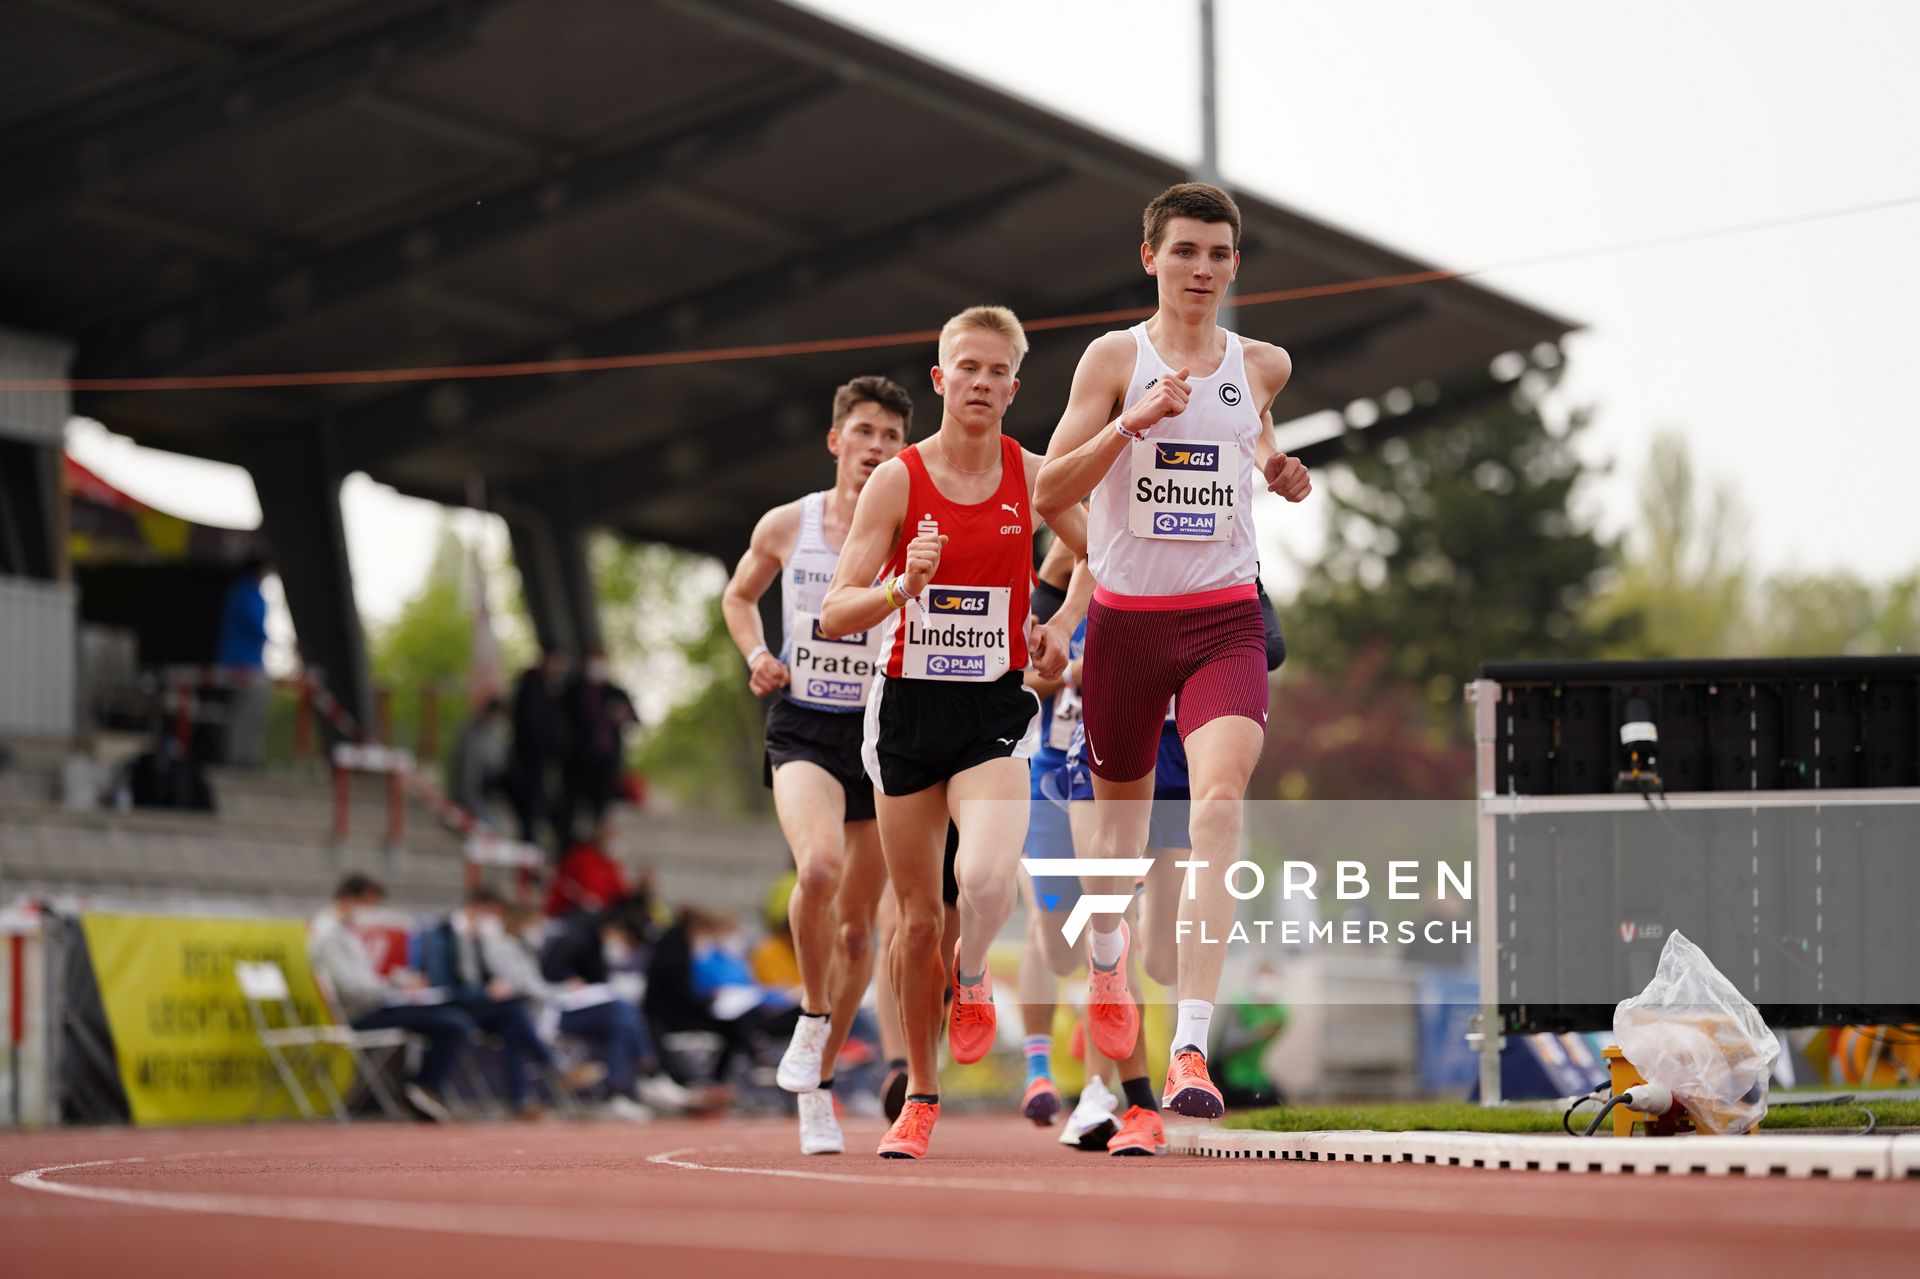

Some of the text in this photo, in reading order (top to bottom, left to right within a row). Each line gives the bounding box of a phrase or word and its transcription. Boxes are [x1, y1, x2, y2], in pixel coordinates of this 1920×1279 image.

[1189, 452, 1214, 466] GLS
[1136, 476, 1234, 507] Schucht
[1180, 516, 1214, 528] PLAN
[960, 597, 985, 611] GLS
[909, 621, 1005, 648] Lindstrot
[951, 658, 983, 669] PLAN
[829, 682, 861, 695] PLAN
